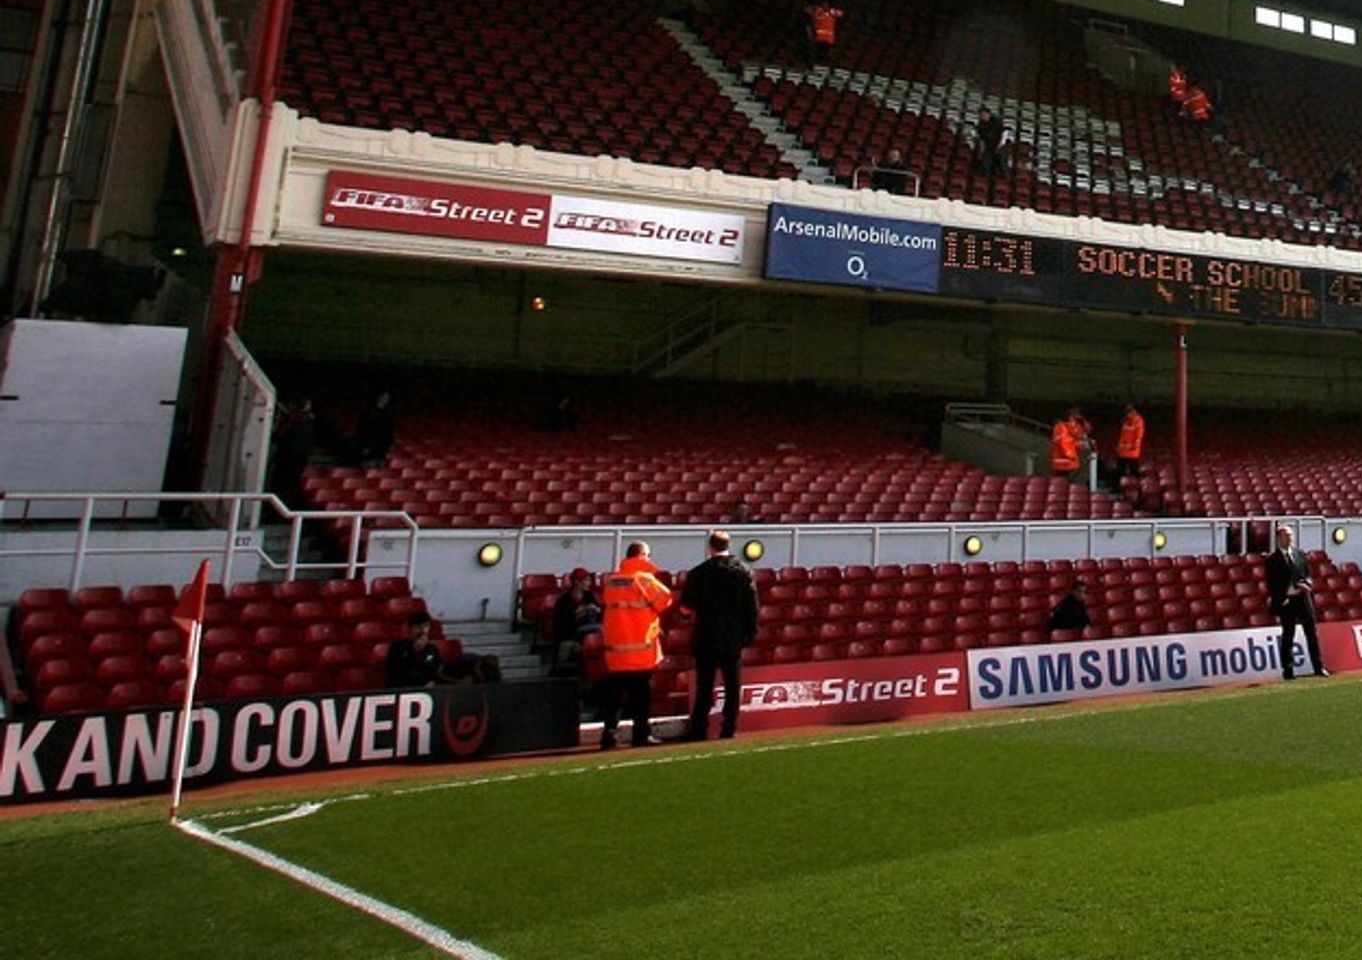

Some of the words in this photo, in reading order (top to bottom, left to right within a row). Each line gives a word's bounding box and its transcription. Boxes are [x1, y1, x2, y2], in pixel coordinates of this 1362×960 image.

[428, 199, 516, 226] Street
[521, 208, 545, 228] 2
[638, 220, 717, 246] Street
[718, 229, 739, 247] 2
[774, 216, 937, 251] ArsenalMobile.com
[943, 231, 1036, 275] 11:31
[1078, 245, 1194, 283] SOCCER
[1207, 260, 1311, 294] SCHOOL
[821, 673, 928, 705] Street
[934, 667, 960, 696] 2
[978, 642, 1188, 700] SAMSUNG
[56, 706, 221, 792] AND
[230, 692, 433, 774] COVER
